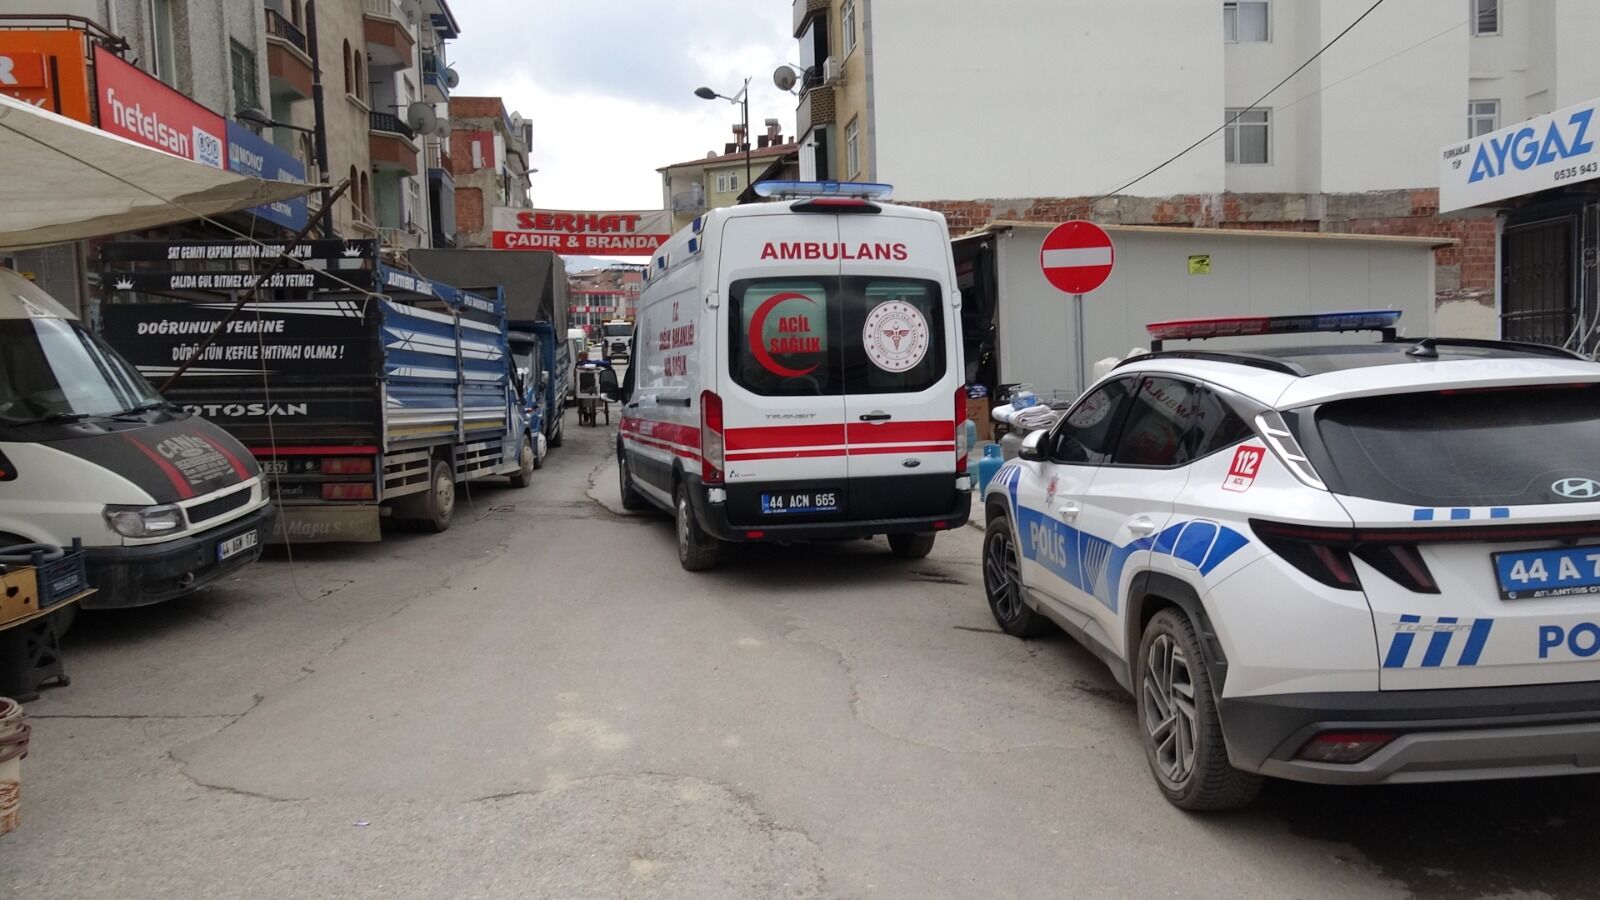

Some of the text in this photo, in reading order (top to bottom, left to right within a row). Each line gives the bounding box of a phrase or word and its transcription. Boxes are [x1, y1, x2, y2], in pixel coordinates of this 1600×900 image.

[111, 100, 190, 158] netelsan
[1467, 108, 1595, 184] AYGAZ
[1554, 162, 1598, 181] 0535 943
[517, 211, 642, 233] SERHAT
[505, 233, 659, 249] ÇADIR & BRANDA
[760, 242, 909, 260] AMBULANS
[168, 246, 180, 259] SAT
[206, 246, 232, 259] KAPTAN
[286, 274, 314, 287] YETMEZ
[137, 319, 285, 335] DOĞRUNUN YEMİNE
[779, 313, 810, 333] ACİL
[304, 345, 337, 359] OLMAZ
[769, 334, 821, 354] SAĞLIK
[1234, 450, 1259, 475] 112
[769, 496, 783, 509] 44
[789, 495, 809, 508] ACN
[815, 493, 835, 507] 665
[1030, 521, 1066, 568] POLİS
[1510, 558, 1549, 583] 44
[1558, 556, 1582, 580] A
[1539, 621, 1600, 658] PO
